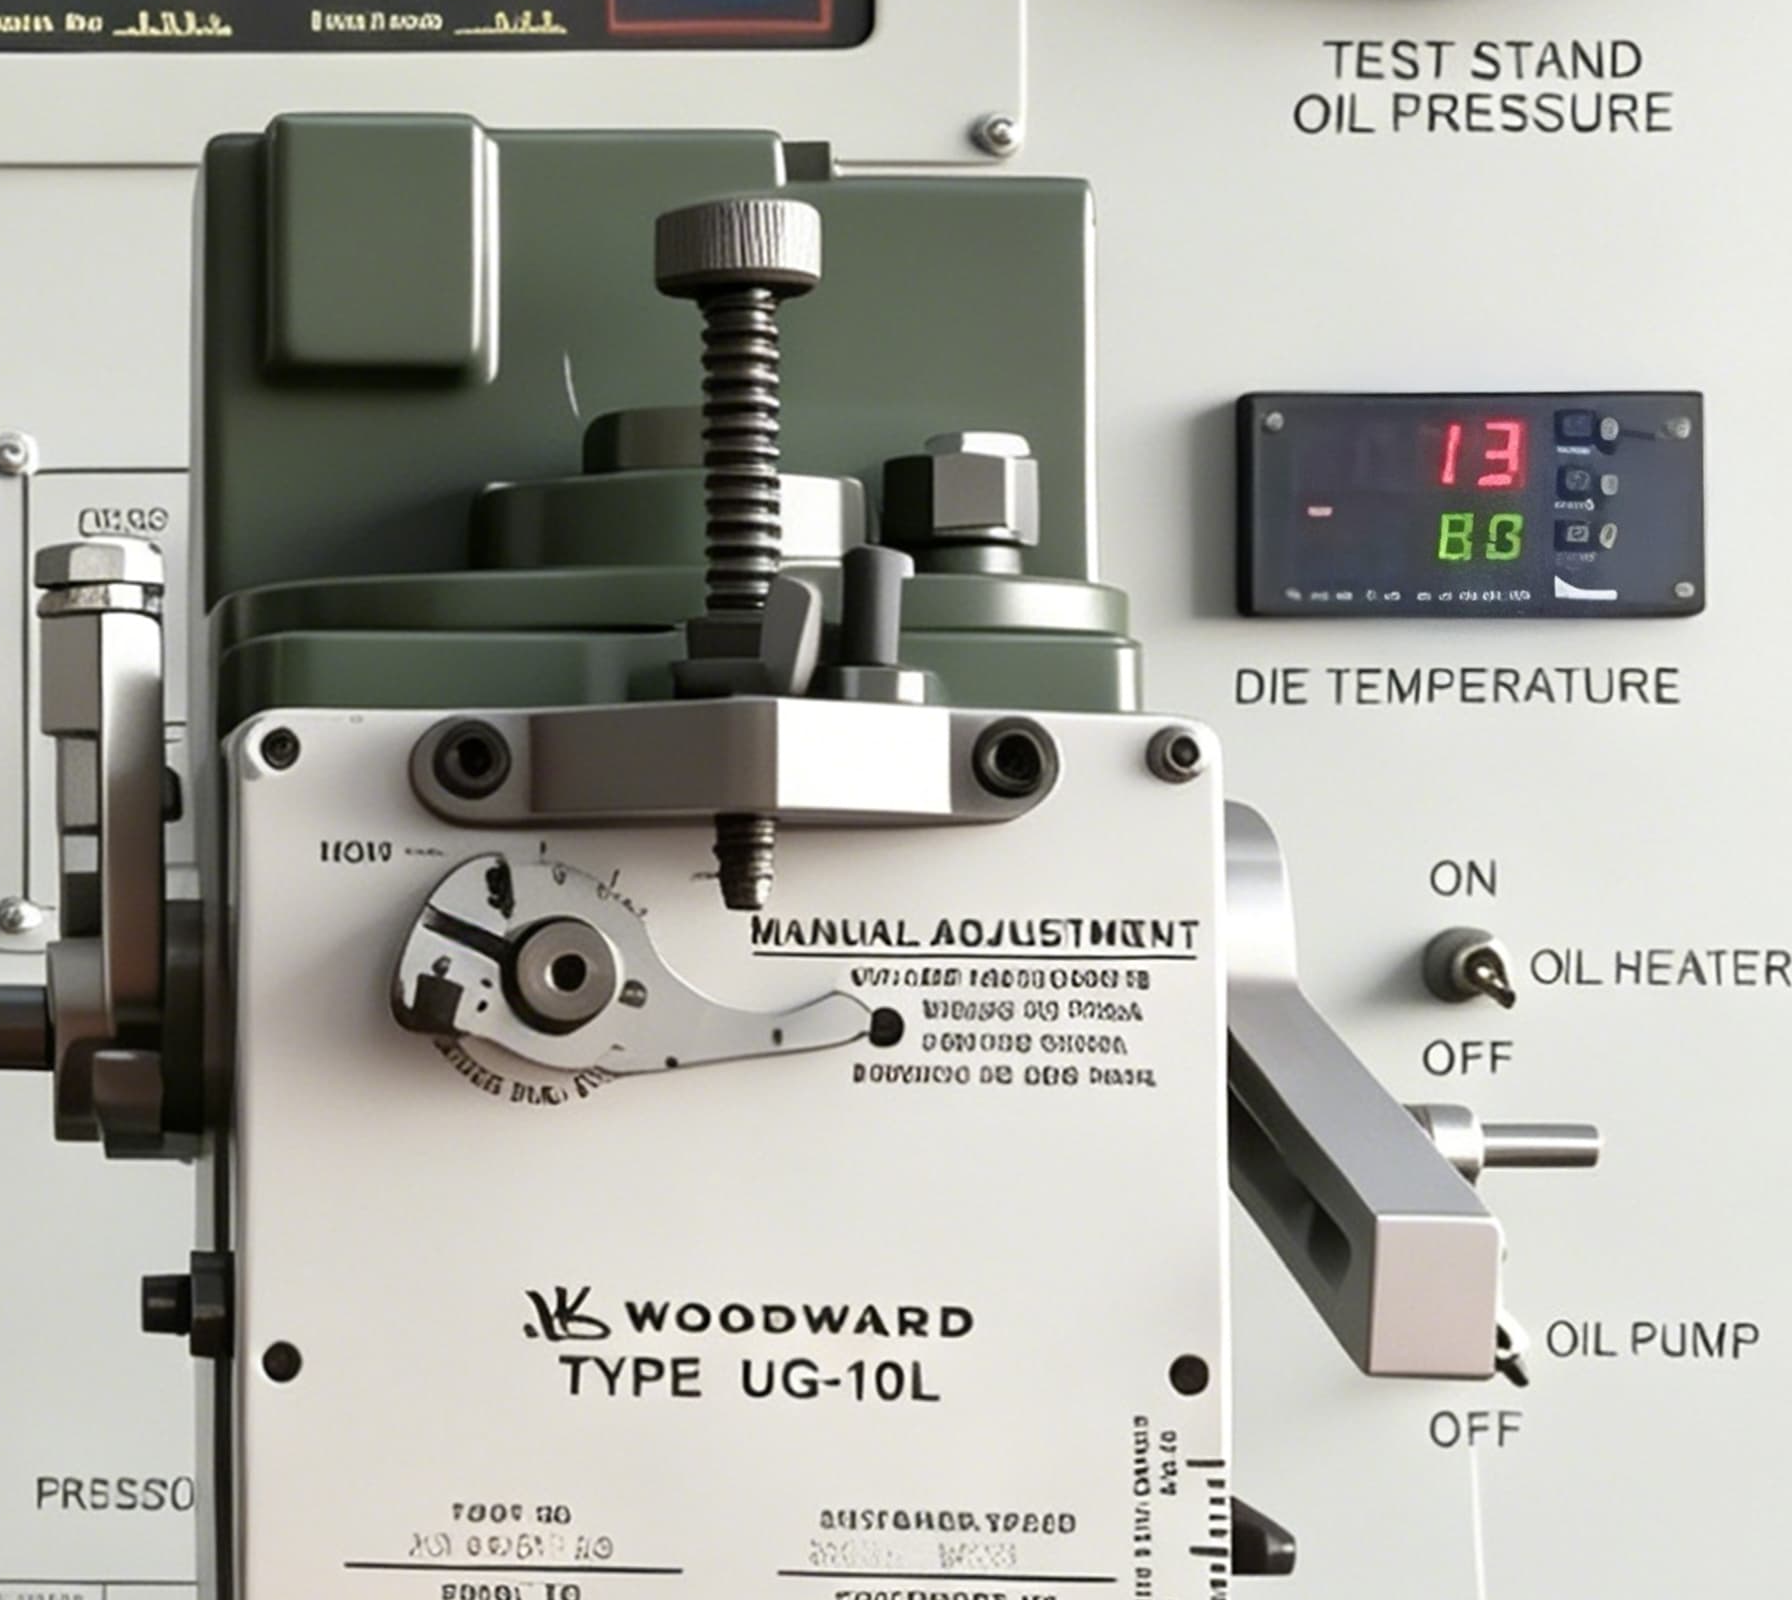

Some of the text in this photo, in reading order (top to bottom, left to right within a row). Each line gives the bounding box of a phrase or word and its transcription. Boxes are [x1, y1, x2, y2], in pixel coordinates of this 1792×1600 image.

[1322, 39, 1643, 82] TEST STAND
[1293, 91, 1672, 135] OIL PRESSURE
[1441, 421, 1521, 486] 13
[1235, 666, 1680, 706] DIE TEMPERATURE
[1429, 859, 1497, 897] ON
[750, 914, 921, 947] MANUAL
[1530, 948, 1792, 987] OIL HEATER
[1422, 1039, 1513, 1077] OFF
[624, 1300, 974, 1338] WOODWARD
[1546, 1319, 1760, 1360] OIL PUMP
[558, 1354, 941, 1402] TYPE UG-10L
[1429, 1410, 1522, 1449] OFF
